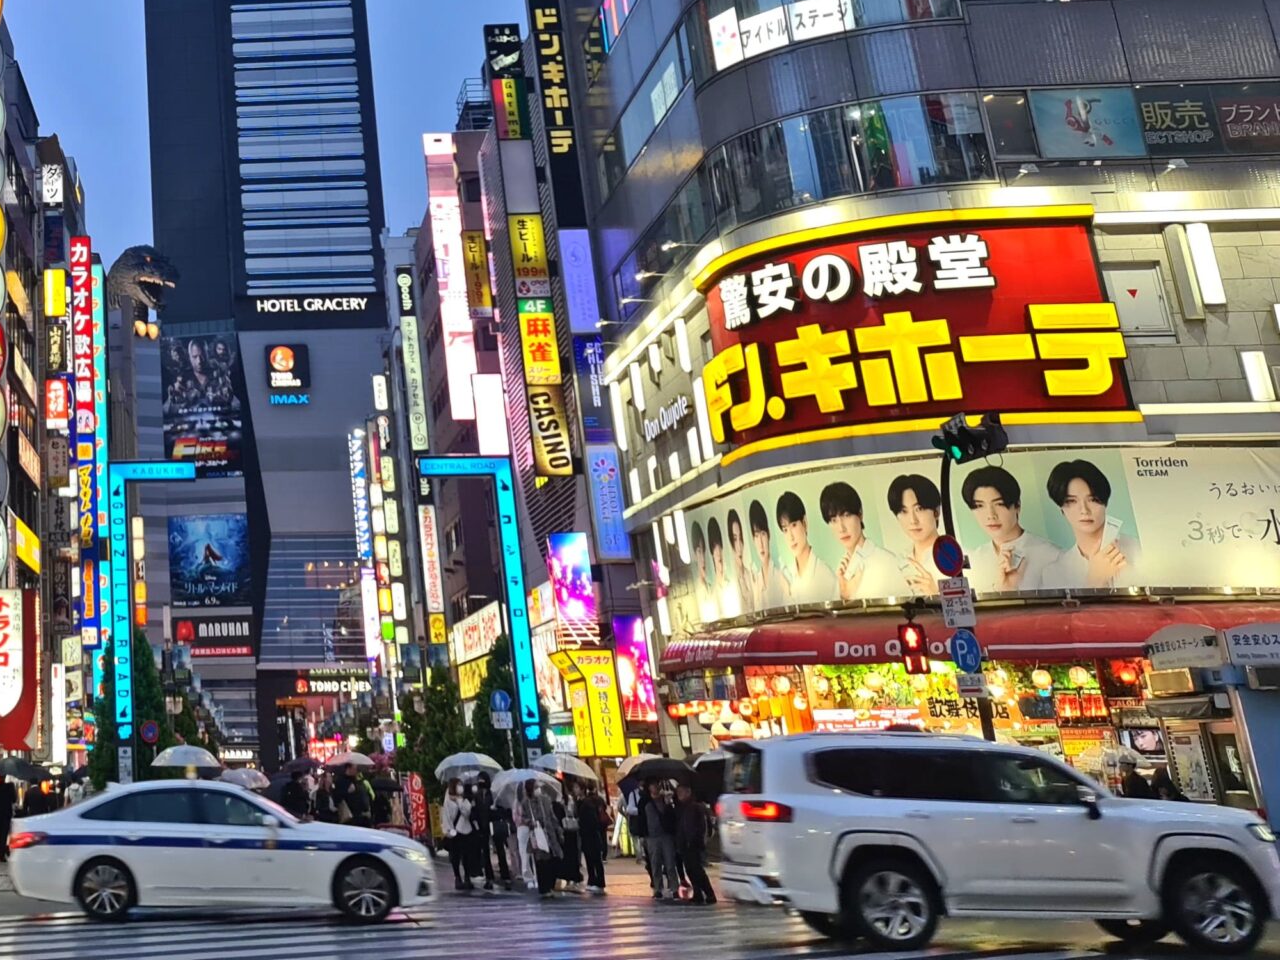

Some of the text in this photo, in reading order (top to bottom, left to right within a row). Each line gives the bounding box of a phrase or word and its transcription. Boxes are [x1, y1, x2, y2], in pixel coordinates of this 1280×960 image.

[740, 1, 849, 49] アイドル ステージ
[1141, 99, 1210, 130] 販売
[517, 219, 533, 263] 生ビール
[720, 234, 996, 331] 驚安の殿堂
[256, 297, 368, 313] HOTEL GRACERY
[524, 301, 547, 313] 4F
[70, 242, 93, 404] カラオケ歌広場
[526, 317, 555, 363] 麻雀
[269, 394, 310, 405] IMAX
[528, 391, 572, 470] CASINO
[644, 395, 689, 442] Don Quijote
[424, 461, 497, 472] CENTRAL ROAD
[1132, 456, 1189, 468] Torriden
[607, 485, 619, 514] IDOL
[111, 501, 129, 699] GODZILLA ROAD
[198, 621, 250, 637] MARUHAN
[576, 656, 611, 665] カラオケ
[834, 640, 877, 658] Don
[956, 639, 968, 666] P
[310, 680, 339, 693] TOHO
[928, 696, 1010, 720] 歌舞伎店
